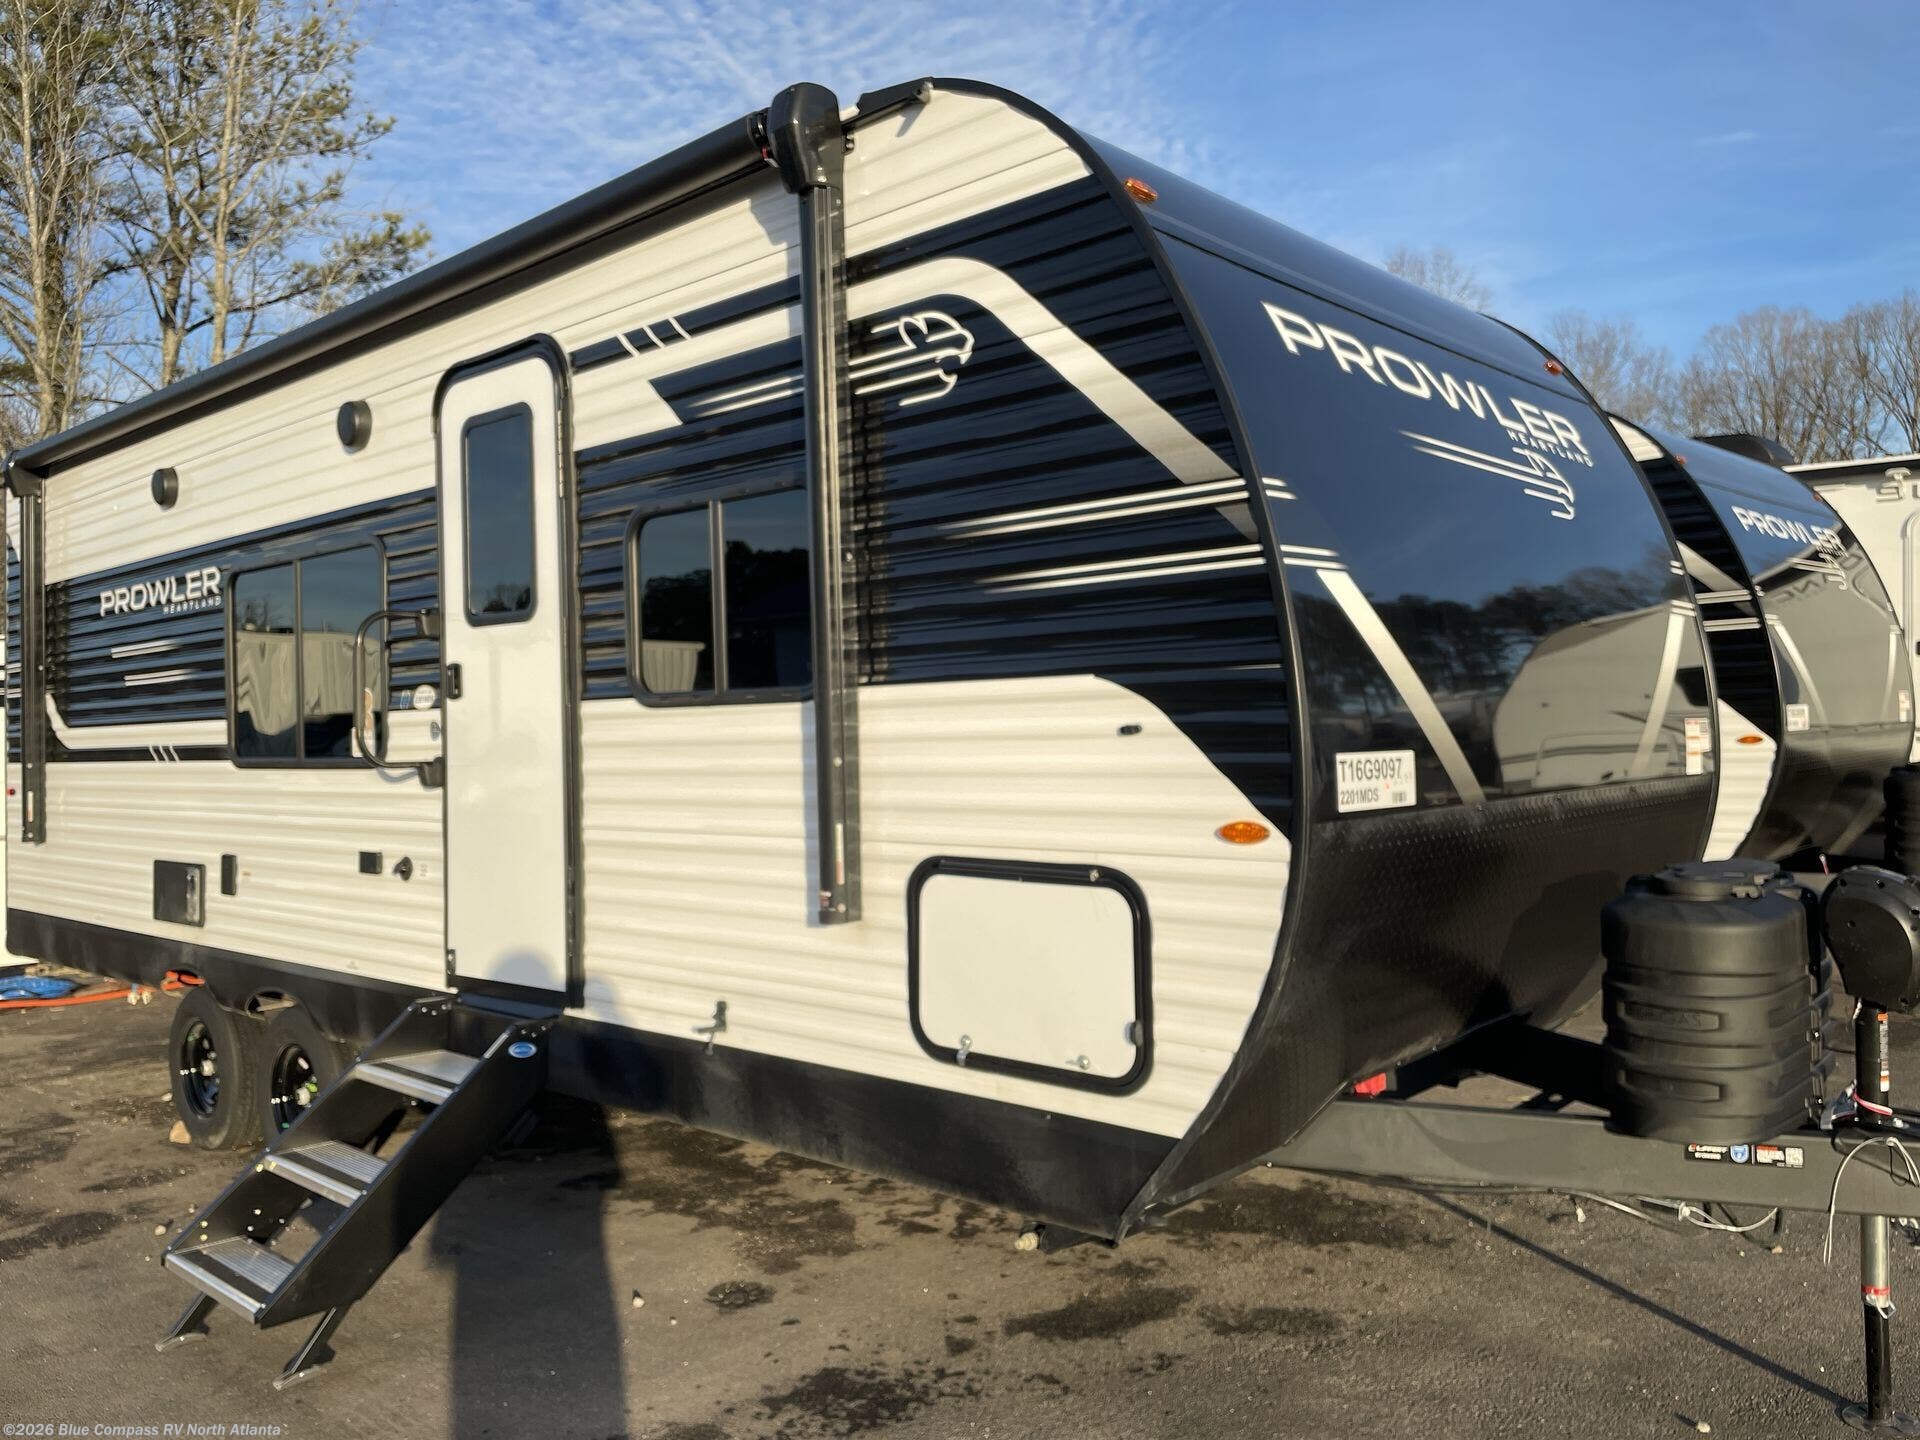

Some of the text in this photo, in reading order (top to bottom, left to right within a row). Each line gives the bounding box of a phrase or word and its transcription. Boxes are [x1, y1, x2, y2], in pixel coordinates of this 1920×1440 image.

[1260, 300, 1589, 456] PROWLER
[1506, 428, 1594, 468] HEARTLAND
[1731, 505, 1848, 558] PROWLER
[99, 565, 221, 618] PROWLER
[162, 595, 222, 615] HEARTLAND
[1339, 757, 1402, 783] T16G9097
[1340, 788, 1379, 805] 2201MDS
